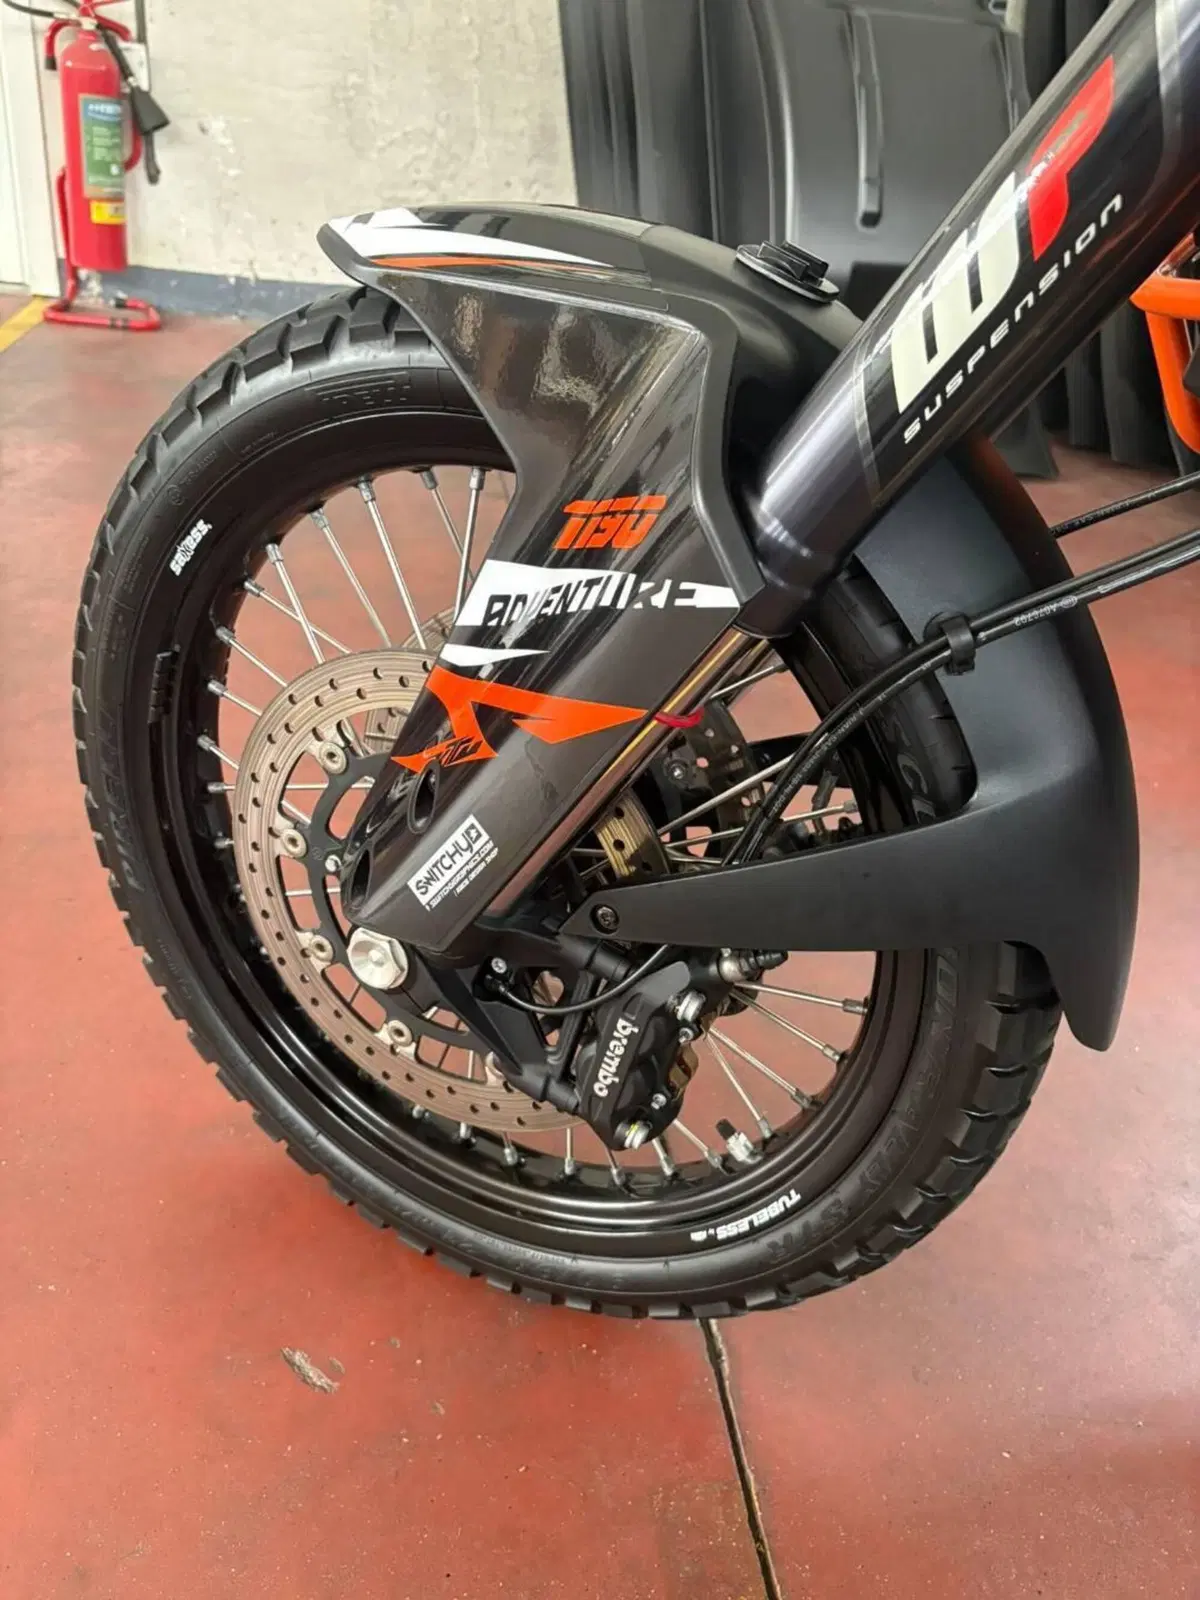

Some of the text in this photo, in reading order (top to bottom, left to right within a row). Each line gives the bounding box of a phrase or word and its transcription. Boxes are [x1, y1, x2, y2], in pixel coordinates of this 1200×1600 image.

[414, 831, 475, 896] SWITCHY
[592, 1018, 640, 1098] brembo
[715, 1188, 802, 1241] TUBELESS
